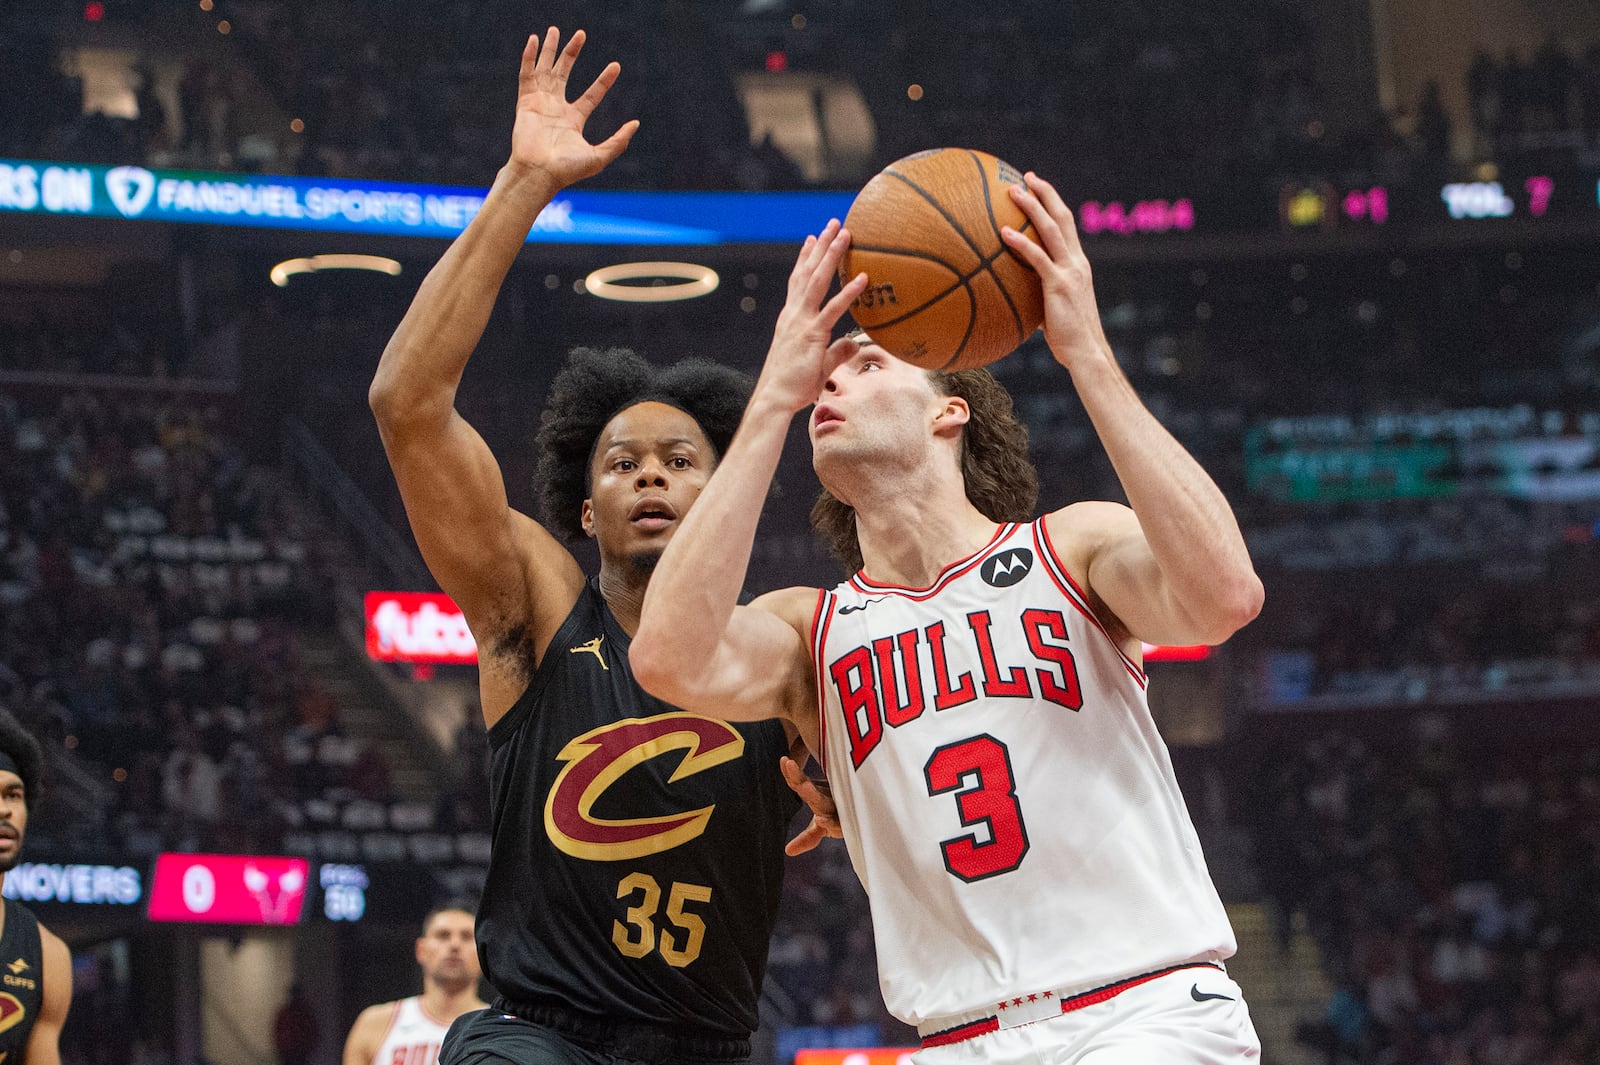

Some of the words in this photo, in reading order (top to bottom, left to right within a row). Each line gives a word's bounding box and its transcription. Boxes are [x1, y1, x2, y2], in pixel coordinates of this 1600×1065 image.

[41, 166, 92, 212] ON
[158, 179, 304, 219] FANDUEL
[304, 187, 423, 227] SPORTS
[1525, 176, 1554, 216] 7
[829, 608, 1084, 772] BULLS
[924, 732, 1031, 884] 3
[182, 864, 216, 914] 0
[612, 872, 714, 968] 35
